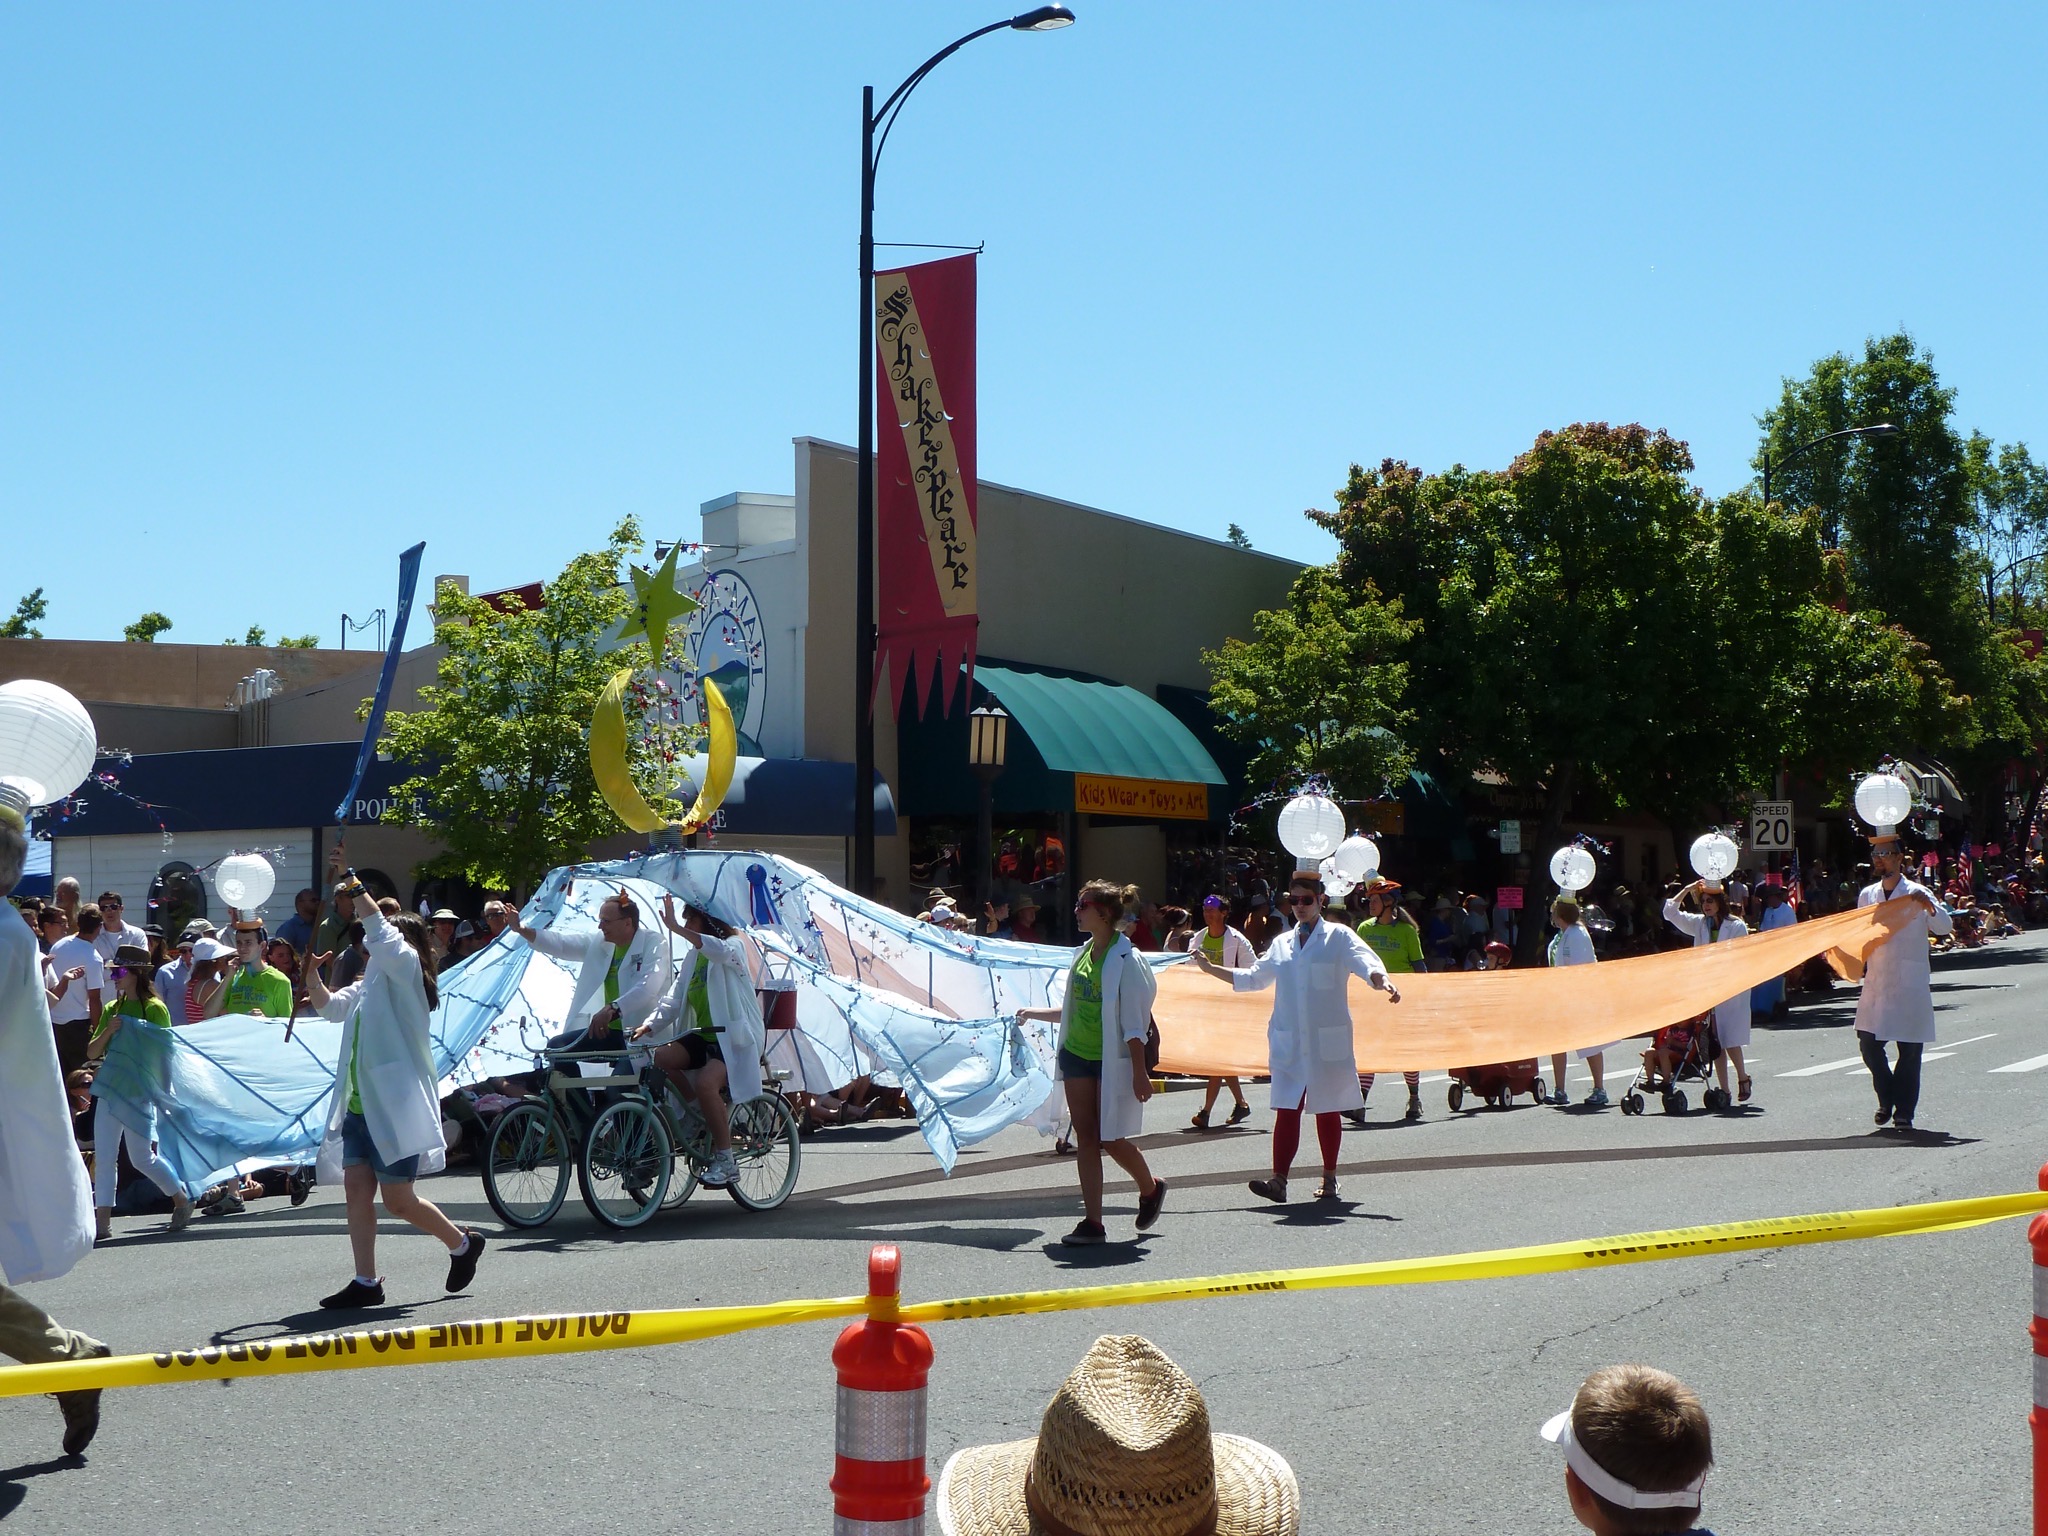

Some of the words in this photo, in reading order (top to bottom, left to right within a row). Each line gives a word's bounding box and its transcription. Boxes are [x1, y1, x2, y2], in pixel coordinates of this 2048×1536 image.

[876, 286, 969, 591] Shakespeare
[354, 797, 423, 820] POLIE
[1079, 782, 1105, 807] Kids
[1108, 786, 1139, 806] Wear
[1149, 789, 1176, 811] Toys
[1186, 792, 1204, 810] Art
[1755, 805, 1789, 815] SPEED
[1755, 818, 1789, 845] 20
[429, 1321, 503, 1348] LINE
[515, 1312, 631, 1342] POLICE
